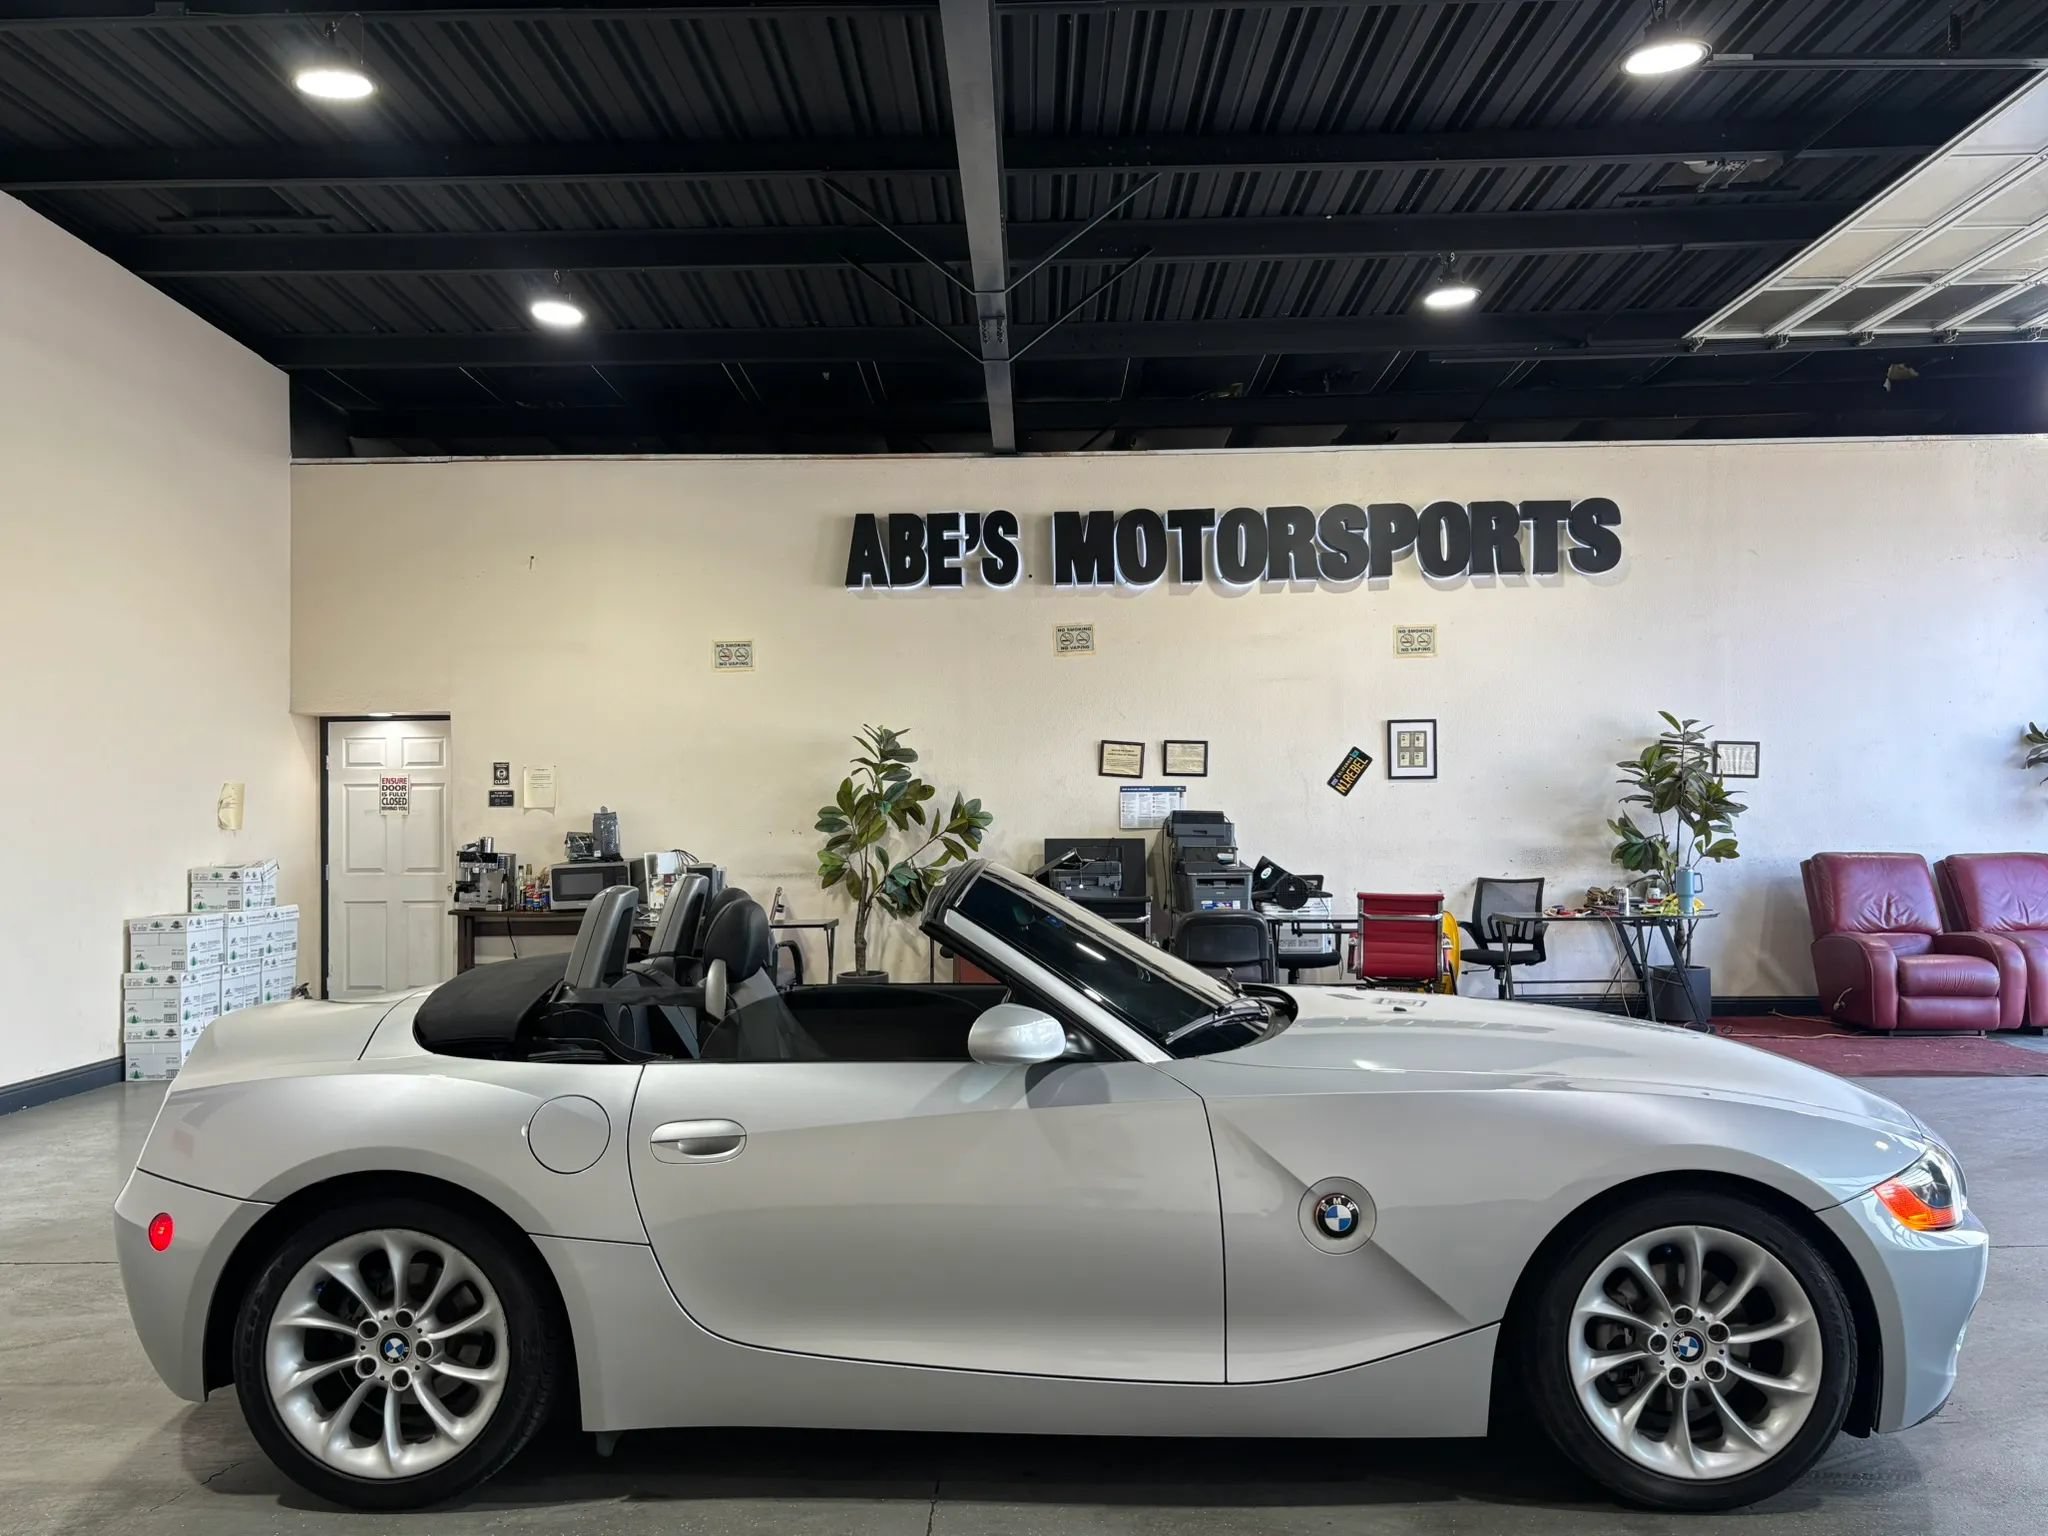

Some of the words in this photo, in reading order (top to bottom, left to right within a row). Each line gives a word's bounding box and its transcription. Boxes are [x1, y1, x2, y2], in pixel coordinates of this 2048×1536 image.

[845, 509, 1019, 588] ABE'S
[1053, 497, 1622, 588] MOTORSPORTS
[381, 777, 408, 785] ENSURE
[381, 797, 408, 806] CLOSED
[1320, 1197, 1356, 1212] BMW
